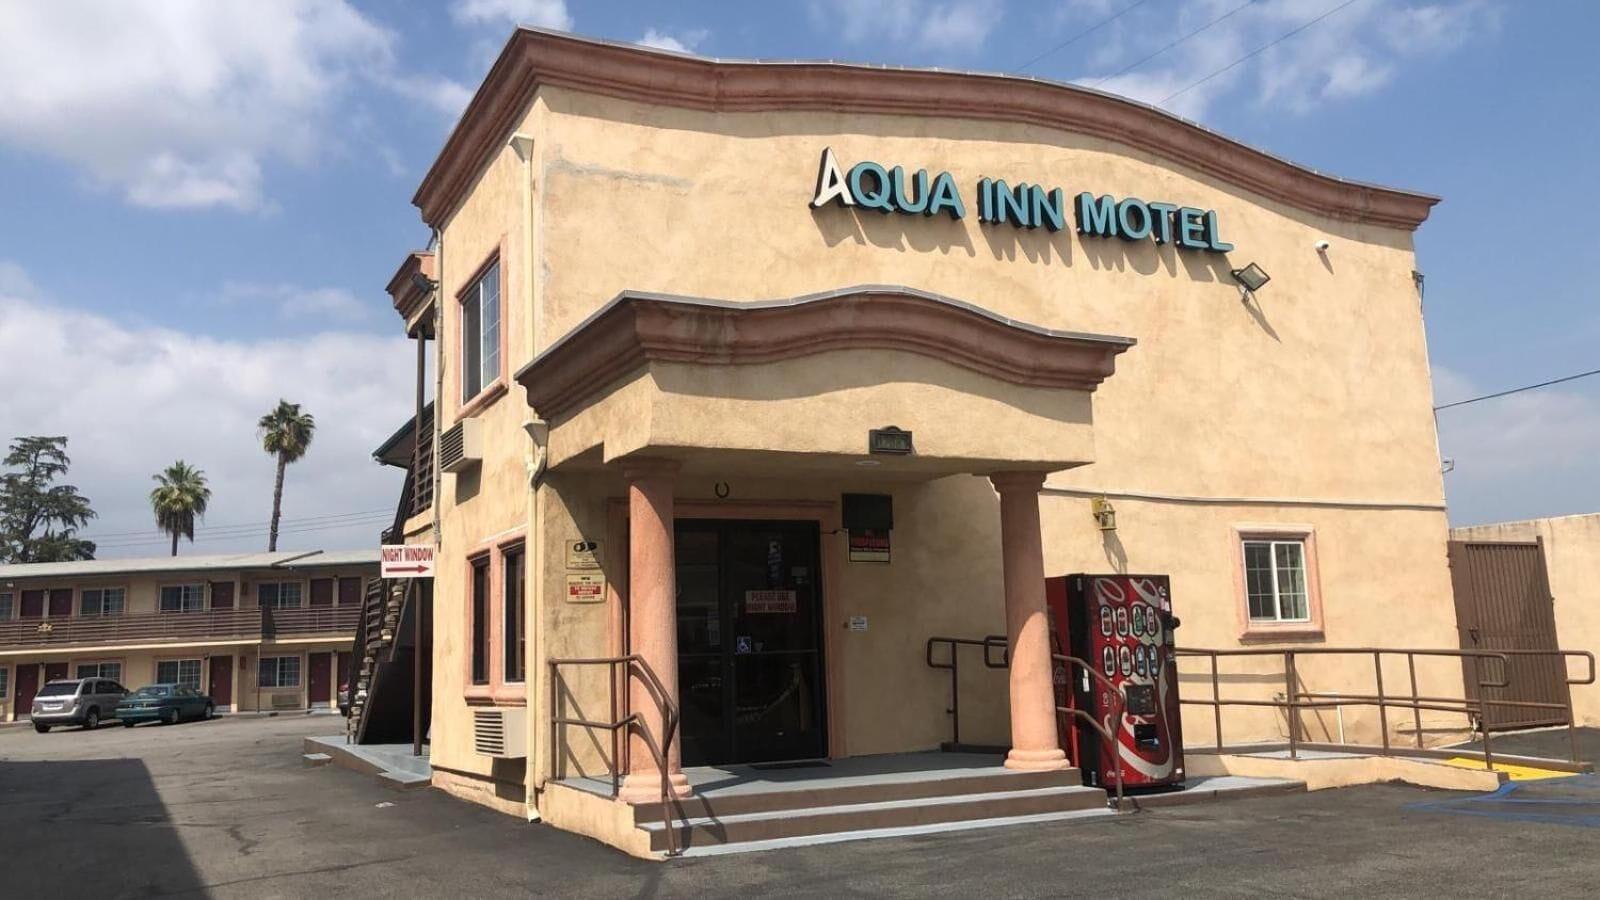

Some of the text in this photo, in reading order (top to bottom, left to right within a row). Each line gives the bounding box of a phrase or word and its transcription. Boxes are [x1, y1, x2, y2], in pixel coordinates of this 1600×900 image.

[809, 146, 1234, 253] AQUA INN MOTEL
[382, 547, 433, 562] NIGHT WINDOW
